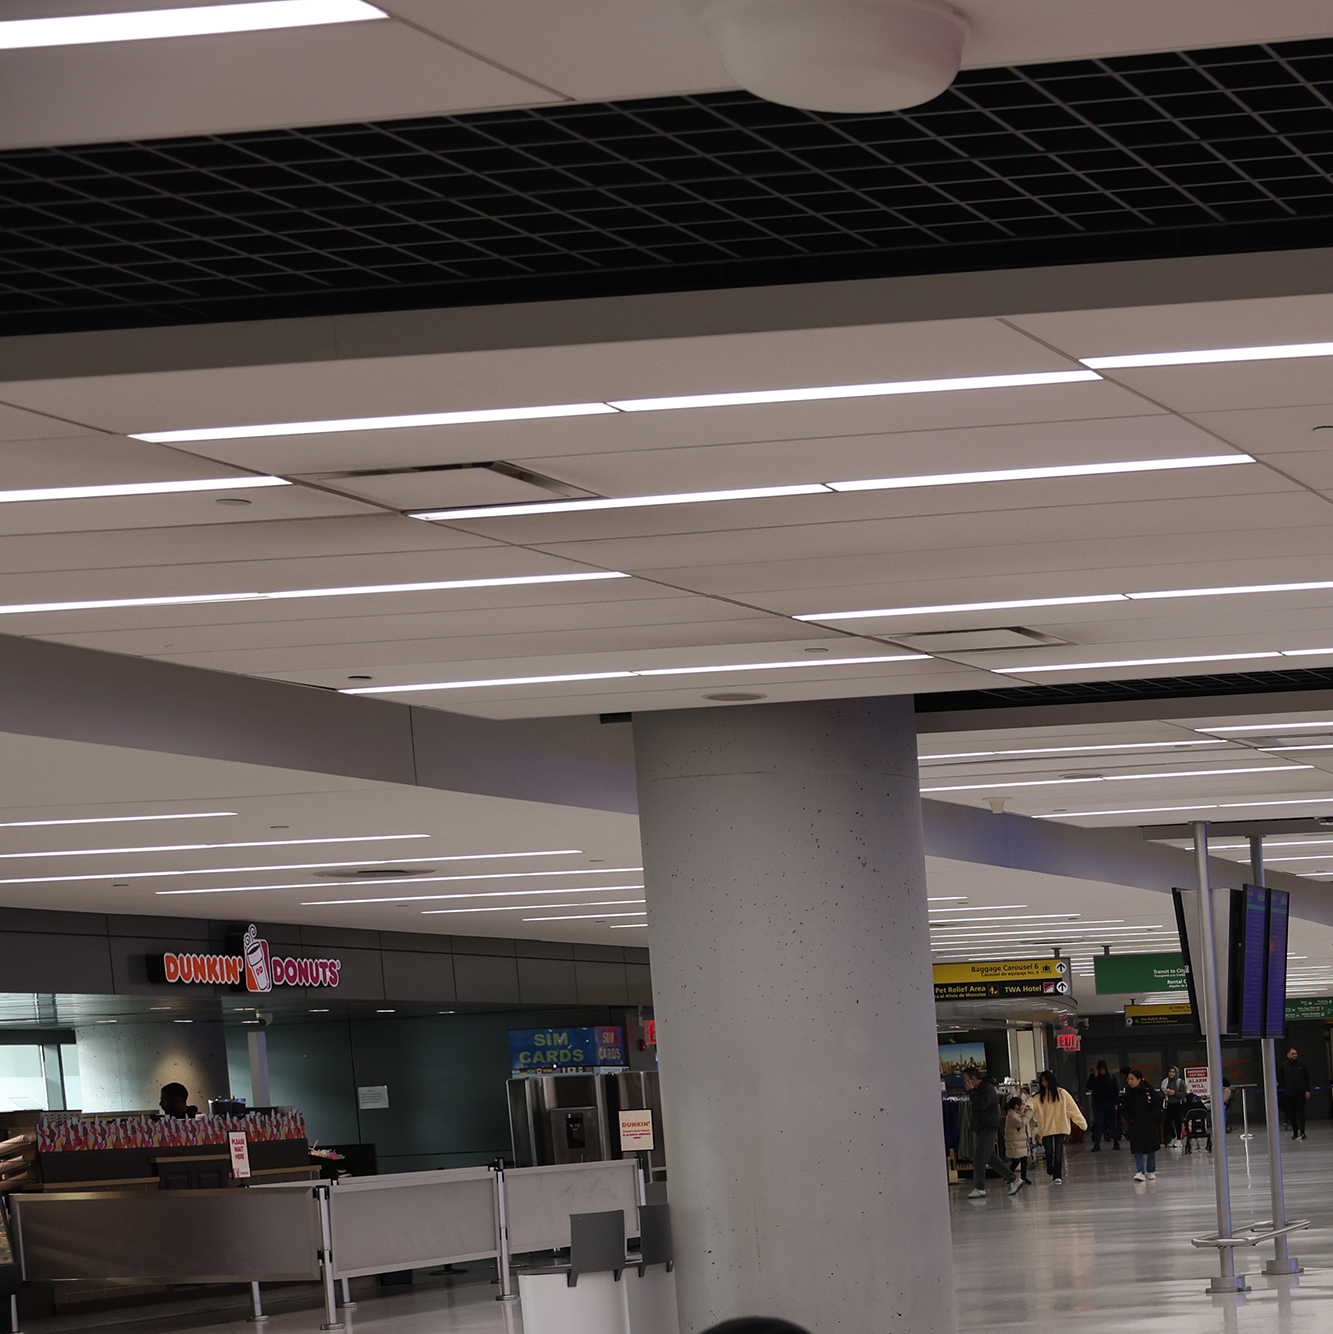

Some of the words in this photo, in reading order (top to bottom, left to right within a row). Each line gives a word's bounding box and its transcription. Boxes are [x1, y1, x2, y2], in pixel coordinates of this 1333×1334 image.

[164, 952, 244, 985] DUNKIN'
[271, 957, 341, 987] DONUTS
[971, 965, 1001, 974] Baggage
[1003, 963, 1033, 971] Carousel
[1022, 984, 1042, 992] Hotel
[534, 1032, 568, 1046] SIM
[602, 1032, 615, 1044] SIM
[1059, 1034, 1075, 1046] EXIT
[519, 1048, 584, 1064] CARDS
[598, 1047, 621, 1060] CARDS
[231, 1138, 246, 1146] PLEASE
